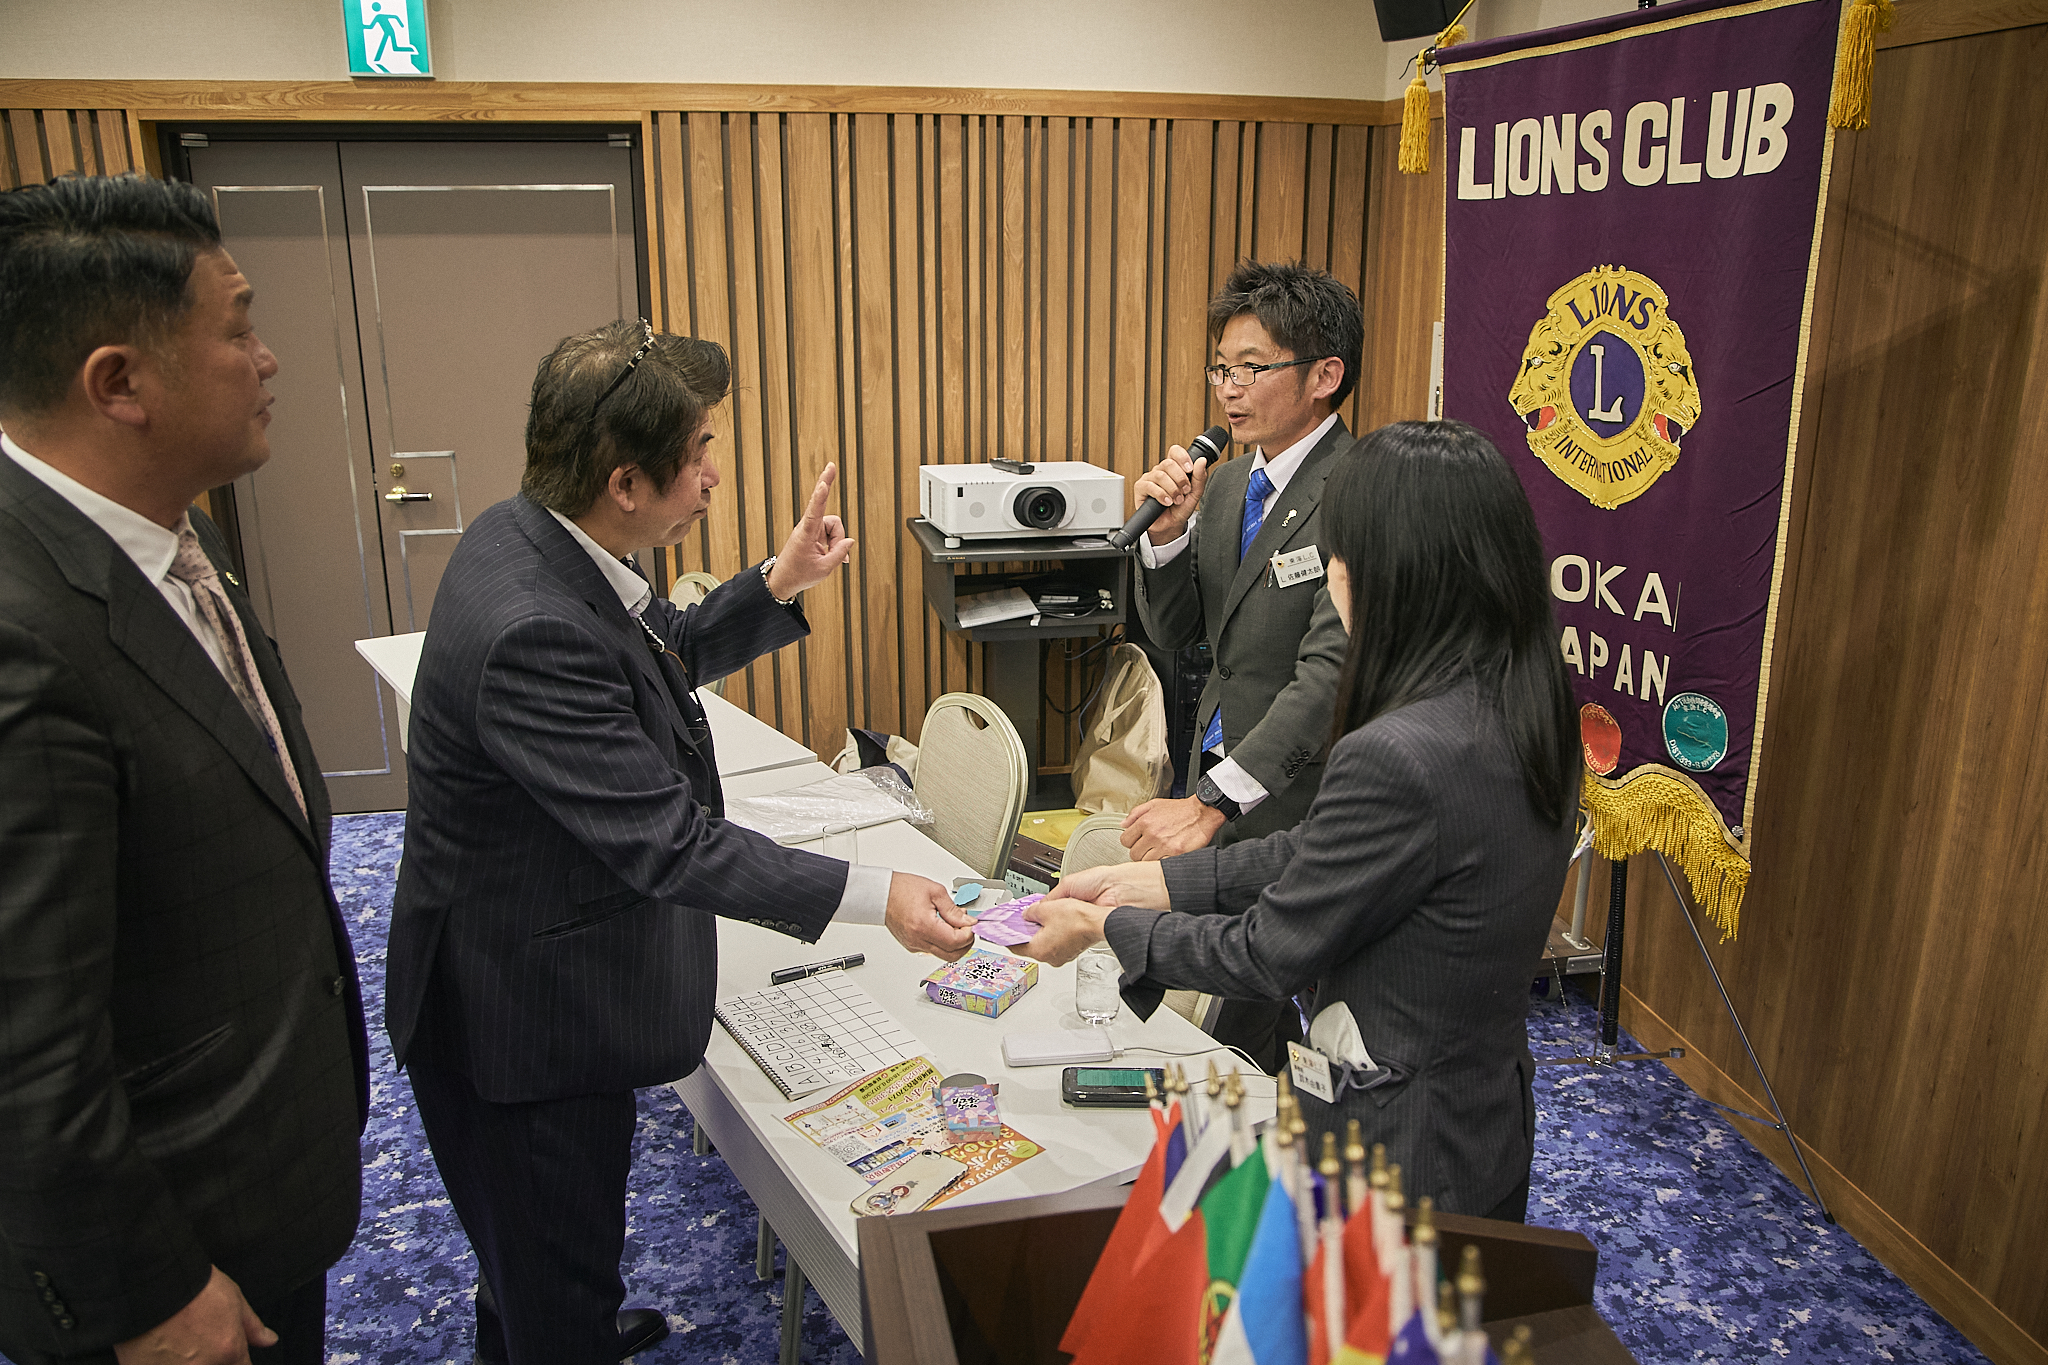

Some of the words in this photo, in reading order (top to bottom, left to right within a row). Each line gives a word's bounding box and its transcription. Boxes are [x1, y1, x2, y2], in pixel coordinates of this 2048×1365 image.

[1457, 109, 1612, 200] LIONS
[1622, 82, 1795, 187] CLUB
[1565, 281, 1659, 331] LIONS
[1588, 344, 1626, 423] L
[1553, 435, 1654, 485] INTERNATIONAL
[1559, 625, 1670, 707] APAN
[766, 1043, 786, 1053] D
[776, 1053, 794, 1061] C
[785, 1063, 806, 1073] B
[798, 1074, 820, 1085] A
